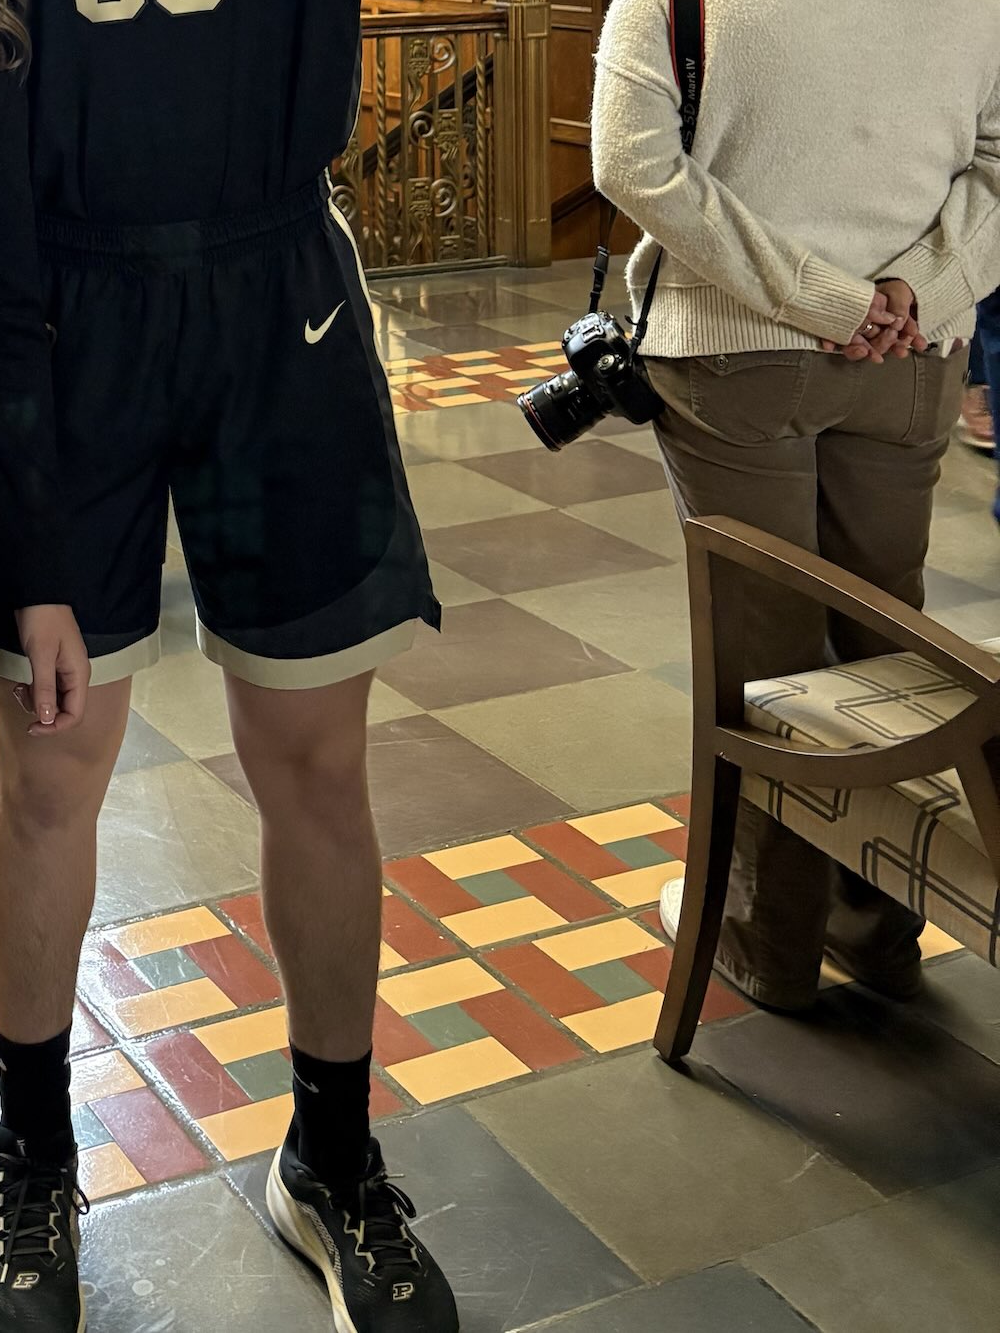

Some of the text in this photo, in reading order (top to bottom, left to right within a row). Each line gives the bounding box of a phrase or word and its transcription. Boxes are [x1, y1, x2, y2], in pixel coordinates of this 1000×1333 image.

[686, 57, 696, 70] IV
[686, 71, 696, 100] Mark
[12, 1272, 40, 1289] P
[392, 1282, 414, 1301] P
